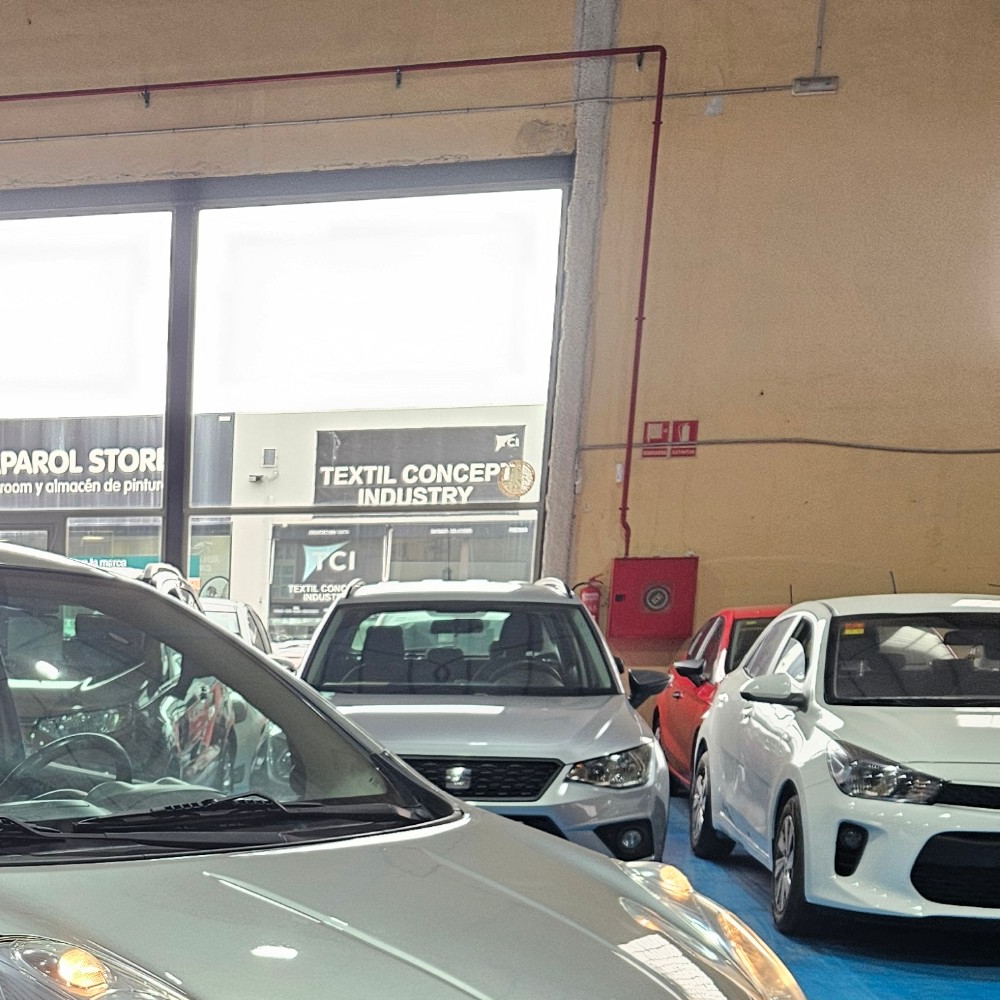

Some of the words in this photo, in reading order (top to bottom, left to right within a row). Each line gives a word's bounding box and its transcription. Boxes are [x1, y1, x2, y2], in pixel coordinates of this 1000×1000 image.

[320, 465, 398, 486] TEXTIL
[402, 462, 516, 485] CONCEPT
[35, 480, 44, 497] y
[46, 477, 101, 494] almacén
[103, 478, 121, 492] de
[357, 486, 474, 506] INDUSTRY
[99, 558, 128, 569] marca
[312, 550, 356, 571] TCI
[288, 584, 319, 594] TEXTIL
